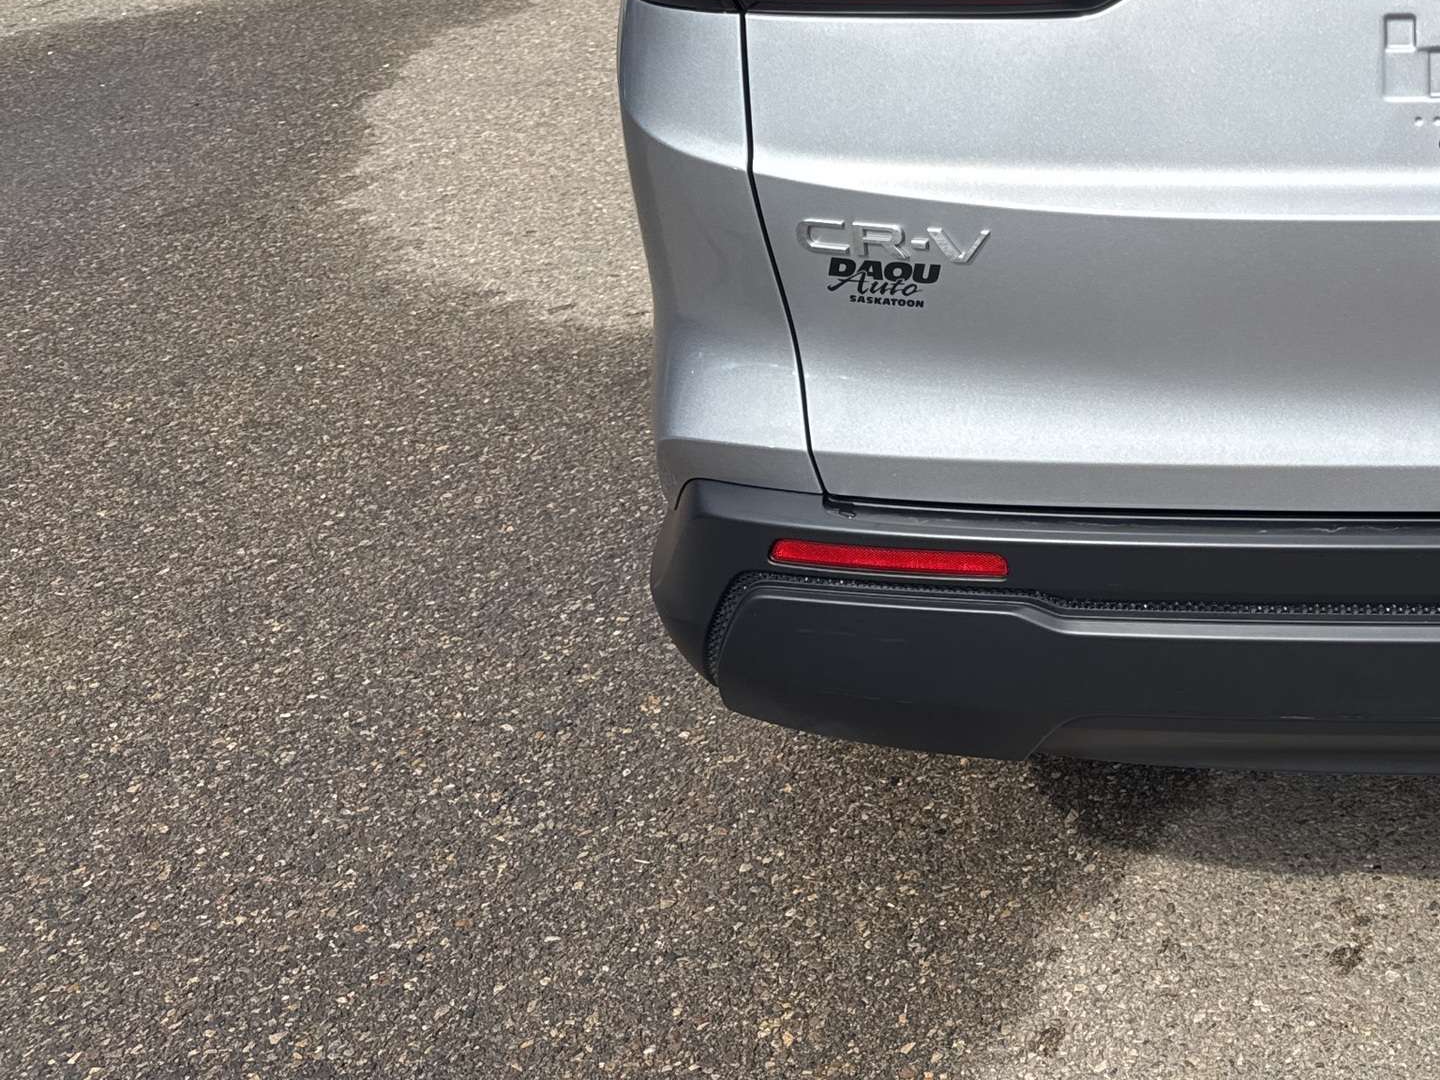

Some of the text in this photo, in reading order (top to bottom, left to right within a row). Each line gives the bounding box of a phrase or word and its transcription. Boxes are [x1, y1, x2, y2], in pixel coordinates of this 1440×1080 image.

[796, 218, 992, 264] CR-V
[827, 257, 942, 284] DAOU
[827, 271, 922, 297] Auto
[849, 295, 925, 308] SASKATOON
